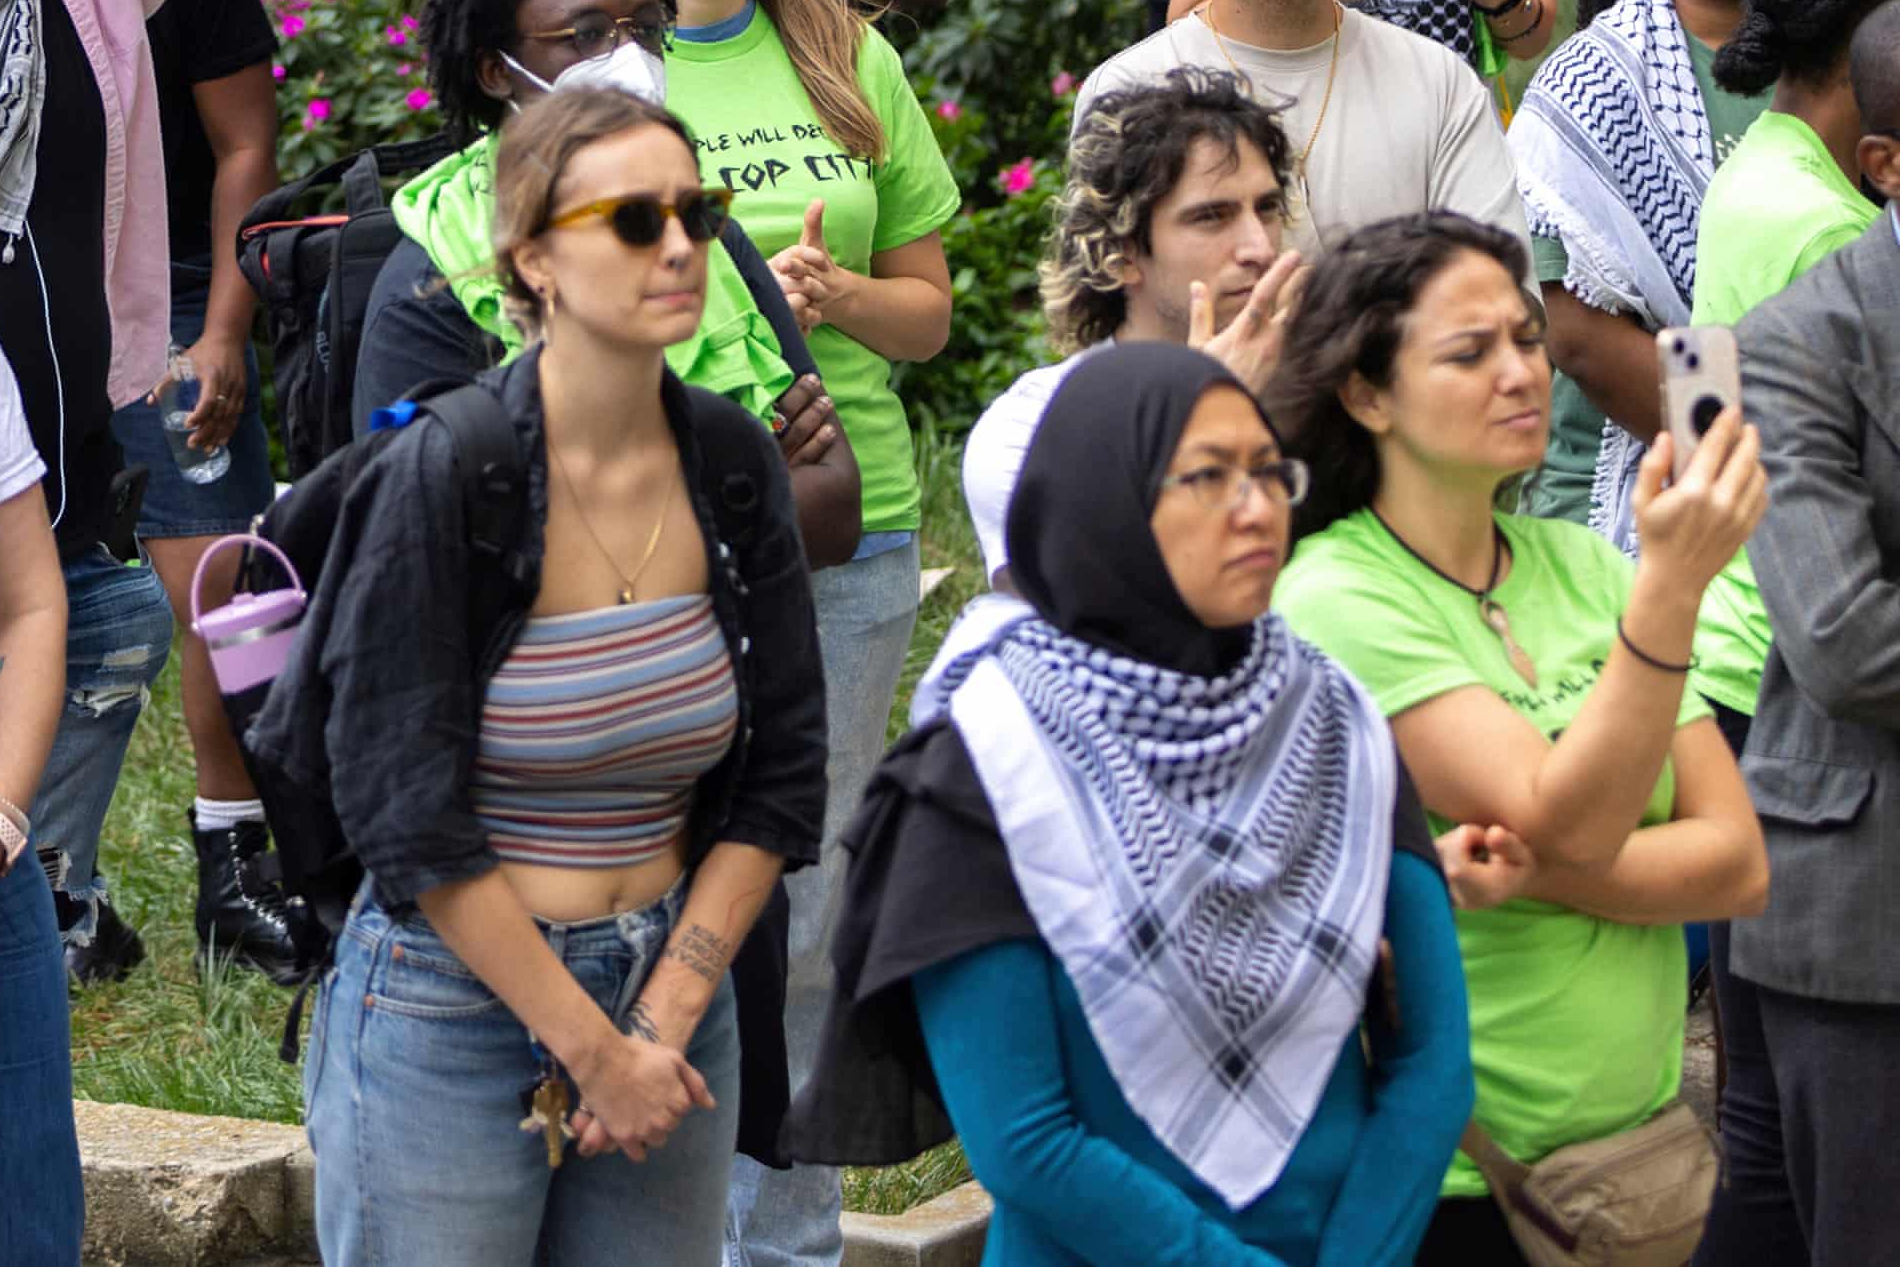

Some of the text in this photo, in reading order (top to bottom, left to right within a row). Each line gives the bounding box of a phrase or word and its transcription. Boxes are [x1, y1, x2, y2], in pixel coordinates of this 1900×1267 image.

[694, 134, 732, 153] PLE
[737, 127, 787, 147] WILL
[718, 158, 791, 193] COP
